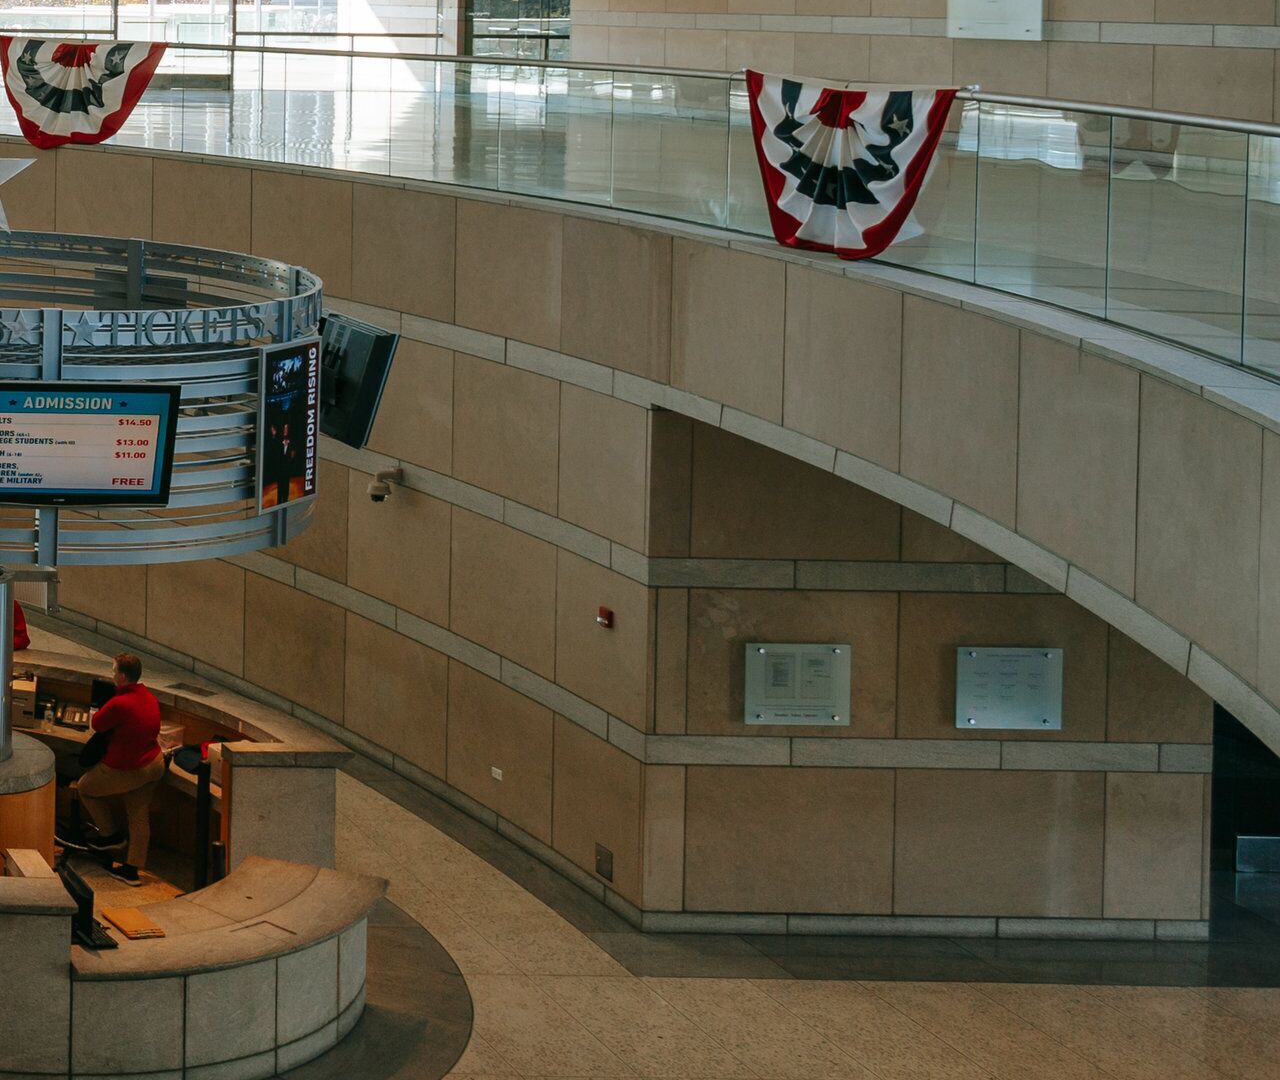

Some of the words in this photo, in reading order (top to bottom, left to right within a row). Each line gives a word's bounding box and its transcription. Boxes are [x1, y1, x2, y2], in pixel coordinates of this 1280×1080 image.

[99, 304, 263, 346] TICKETS
[307, 347, 318, 405] RISING
[23, 396, 113, 410] ADMISSION
[118, 419, 152, 427] $14.50
[304, 409, 315, 491] FREEDOM
[6, 477, 43, 485] MILITARY
[112, 478, 145, 486] FREE
